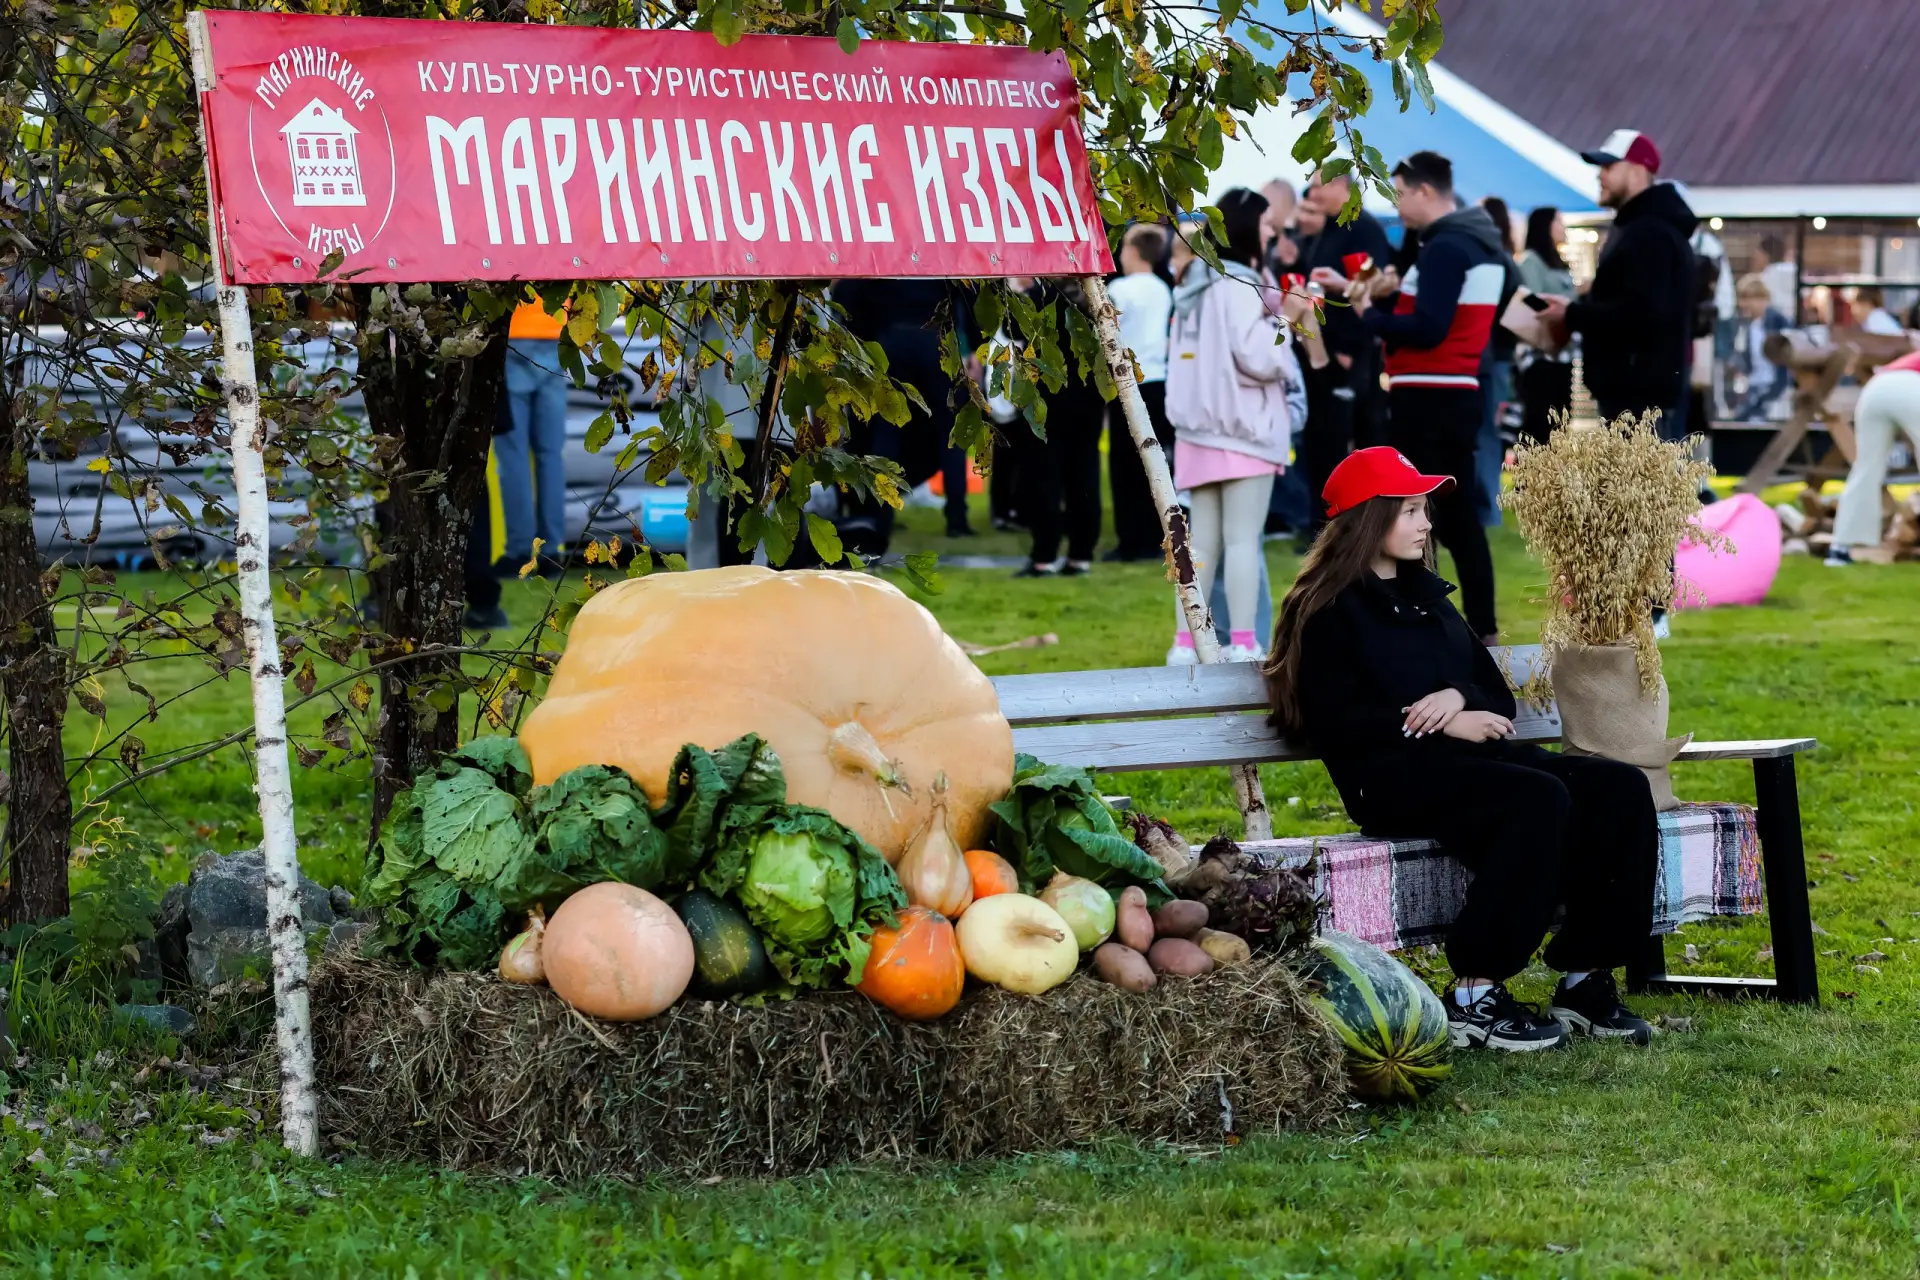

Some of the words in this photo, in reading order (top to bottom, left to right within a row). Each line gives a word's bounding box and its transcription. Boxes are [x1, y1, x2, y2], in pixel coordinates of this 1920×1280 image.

[255, 45, 375, 112] МАРИИНСКИЕ
[417, 61, 893, 104] КУЛЬТУРНО-ТУРИСТИЧЕСКИЙ
[900, 76, 1060, 109] КОМПЛЕКС
[425, 115, 895, 245] МАРИИНСКИЕ
[904, 125, 1090, 244] ИЗБЫ
